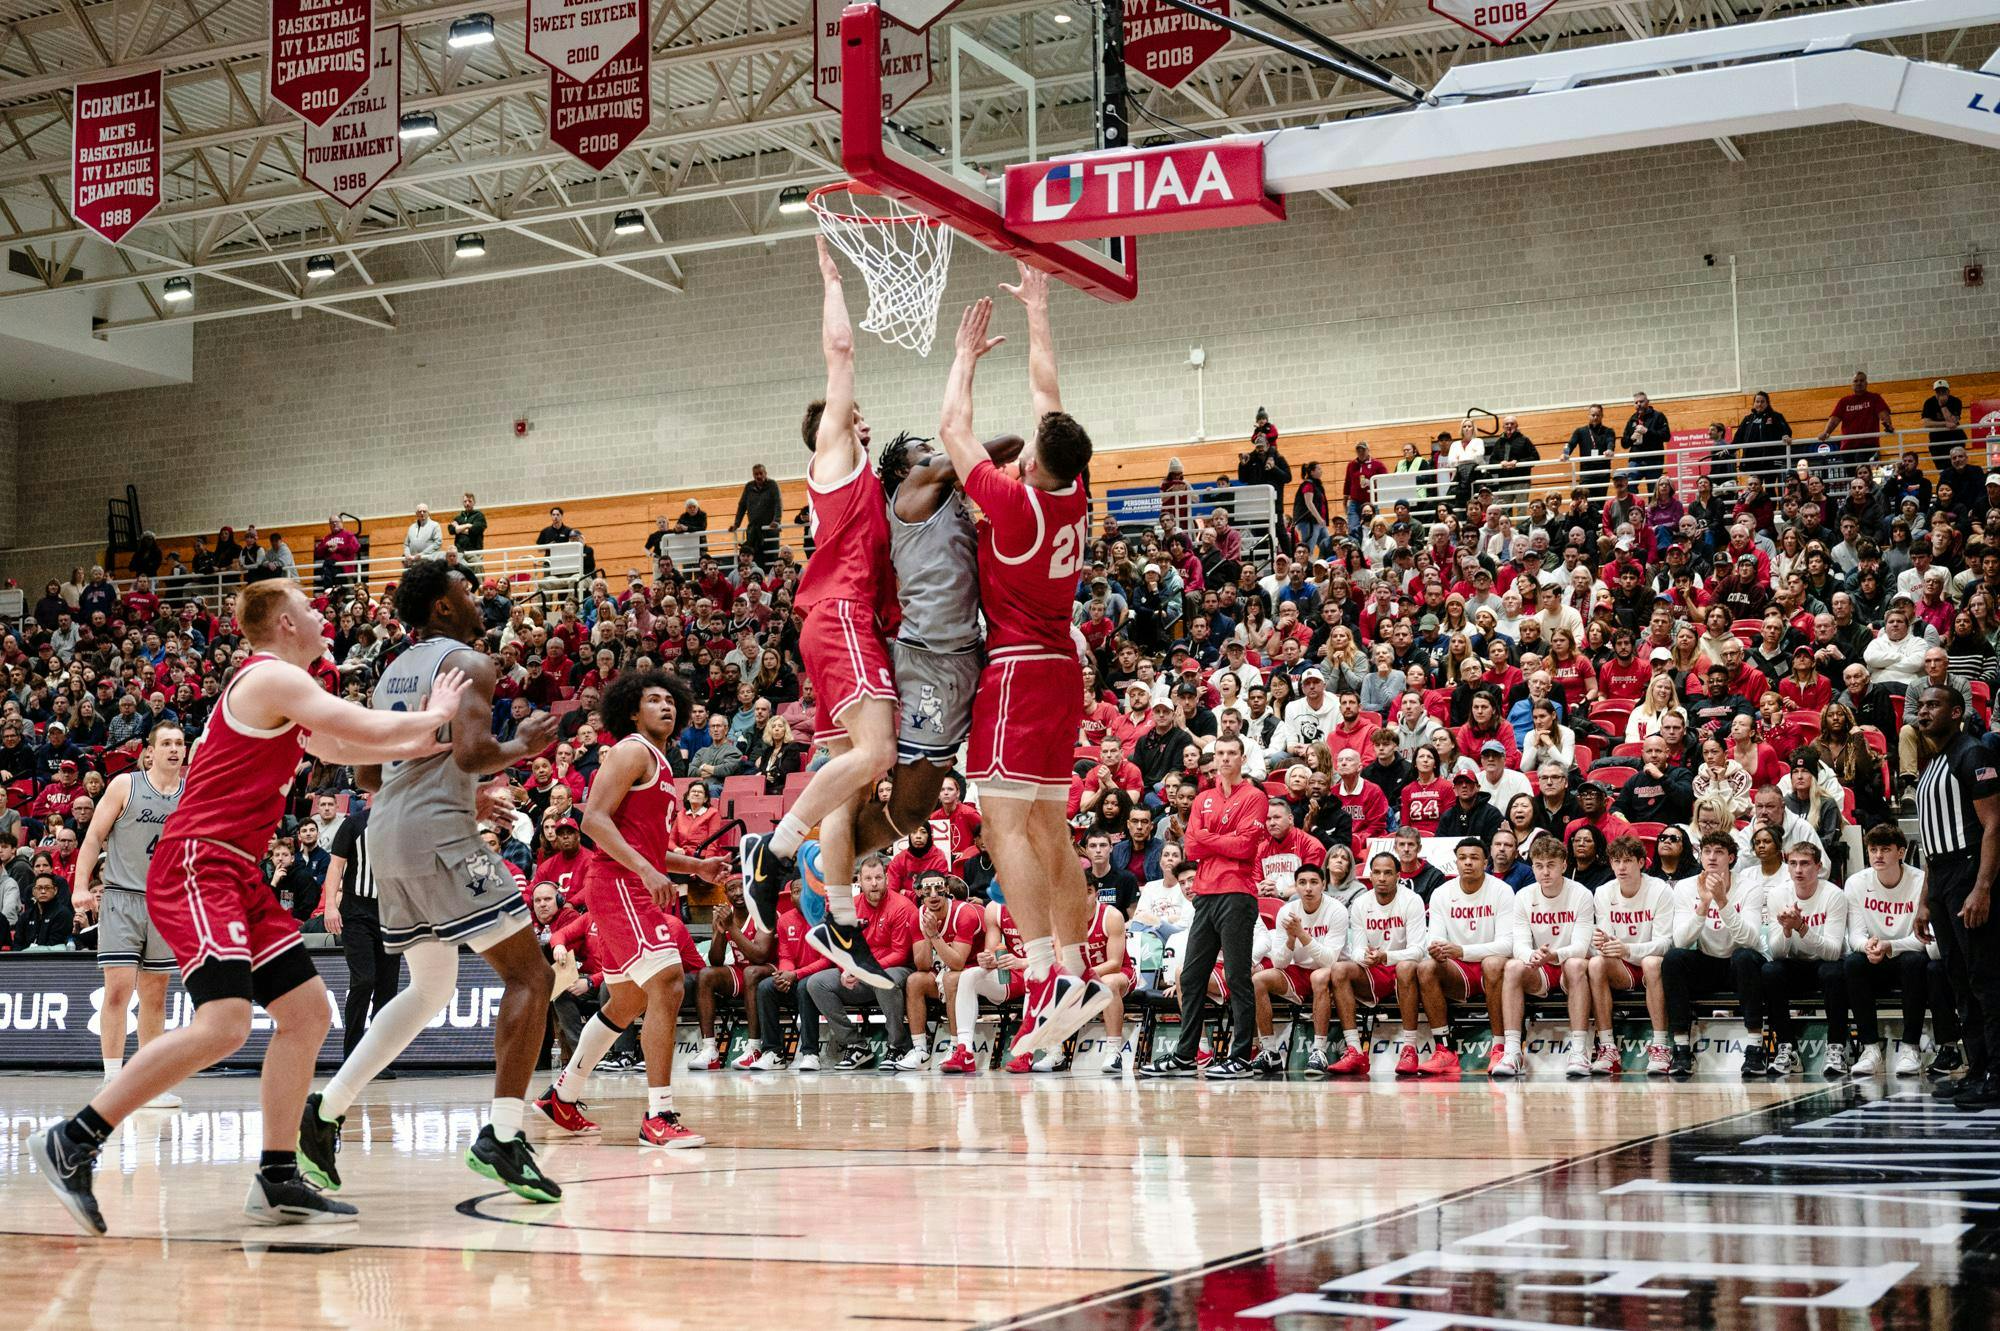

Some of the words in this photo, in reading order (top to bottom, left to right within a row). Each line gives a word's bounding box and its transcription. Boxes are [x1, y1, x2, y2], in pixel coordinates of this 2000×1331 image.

[278, 6, 365, 36] BASKETBALL
[533, 14, 576, 32] SWEET
[581, 2, 636, 27] SIXTEEN
[1474, 2, 1528, 26] 2008
[280, 38, 303, 57] IVY
[308, 27, 360, 53] LEAGUE
[567, 45, 599, 64] 2010
[1146, 46, 1193, 70] 2008
[277, 48, 365, 85] CHAMPIONS
[301, 88, 339, 110] 2010
[561, 86, 583, 104] IVY
[588, 77, 640, 101] LEAGUE
[80, 89, 155, 119] CORNELL
[557, 97, 643, 130] CHAMPIONS
[99, 123, 136, 142] MEN'S
[332, 122, 367, 142] NCAA
[79, 138, 154, 163] BASKETBALL
[308, 136, 394, 164] TOURNAMENT
[579, 133, 619, 154] 2008
[82, 165, 102, 182] IVY
[105, 158, 151, 179] LEAGUE
[79, 176, 154, 207] CHAMPIONS
[333, 172, 367, 192] 1988
[1094, 151, 1234, 214] TIAA
[100, 208, 131, 228] 1988
[1049, 515, 1085, 579] 21
[878, 668, 892, 687] C
[911, 715, 927, 730] Y
[1203, 798, 1212, 809] C
[1409, 799, 1439, 820] 24
[136, 808, 168, 824] Bull
[557, 871, 573, 893] C
[1451, 907, 1474, 919] LOCK
[1864, 897, 1891, 914] LOCK
[1470, 921, 1476, 931] C
[1531, 911, 1556, 924] LOCK
[1610, 911, 1633, 924] LOCK
[1714, 920, 1721, 930] C
[1885, 916, 1894, 927] C
[227, 921, 247, 945] C
[655, 924, 671, 941] C
[788, 926, 795, 937] C
[1384, 931, 1391, 941] C
[1552, 926, 1560, 936] C
[1629, 926, 1637, 936] C
[1456, 1038, 1492, 1058] Ivy
[1616, 1035, 1651, 1057] Ivy
[1714, 1040, 1744, 1053] TIA
[1797, 1039, 1827, 1058] vy
